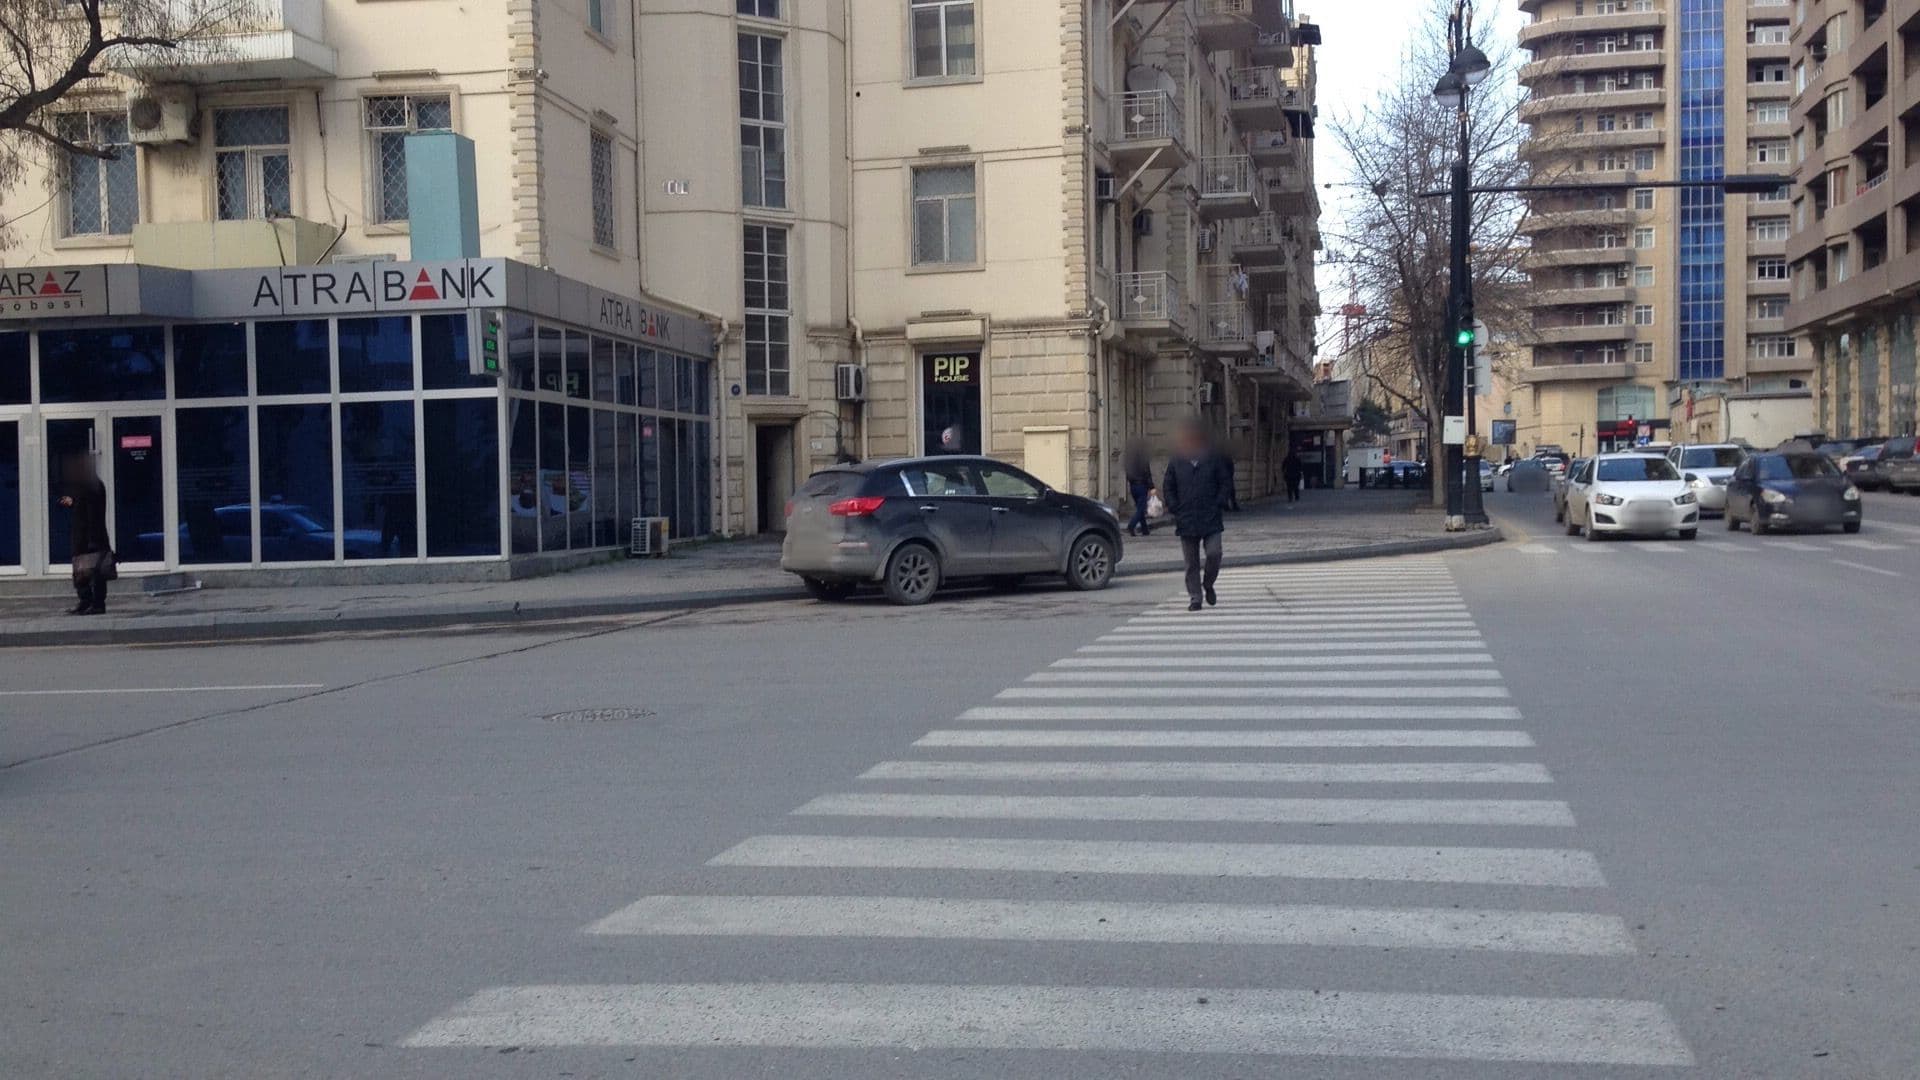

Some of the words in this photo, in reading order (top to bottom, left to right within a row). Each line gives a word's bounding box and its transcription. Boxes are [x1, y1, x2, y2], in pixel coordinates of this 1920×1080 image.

[600, 297, 633, 332] ATRA
[640, 309, 670, 341] BANK
[934, 356, 970, 376] PIP
